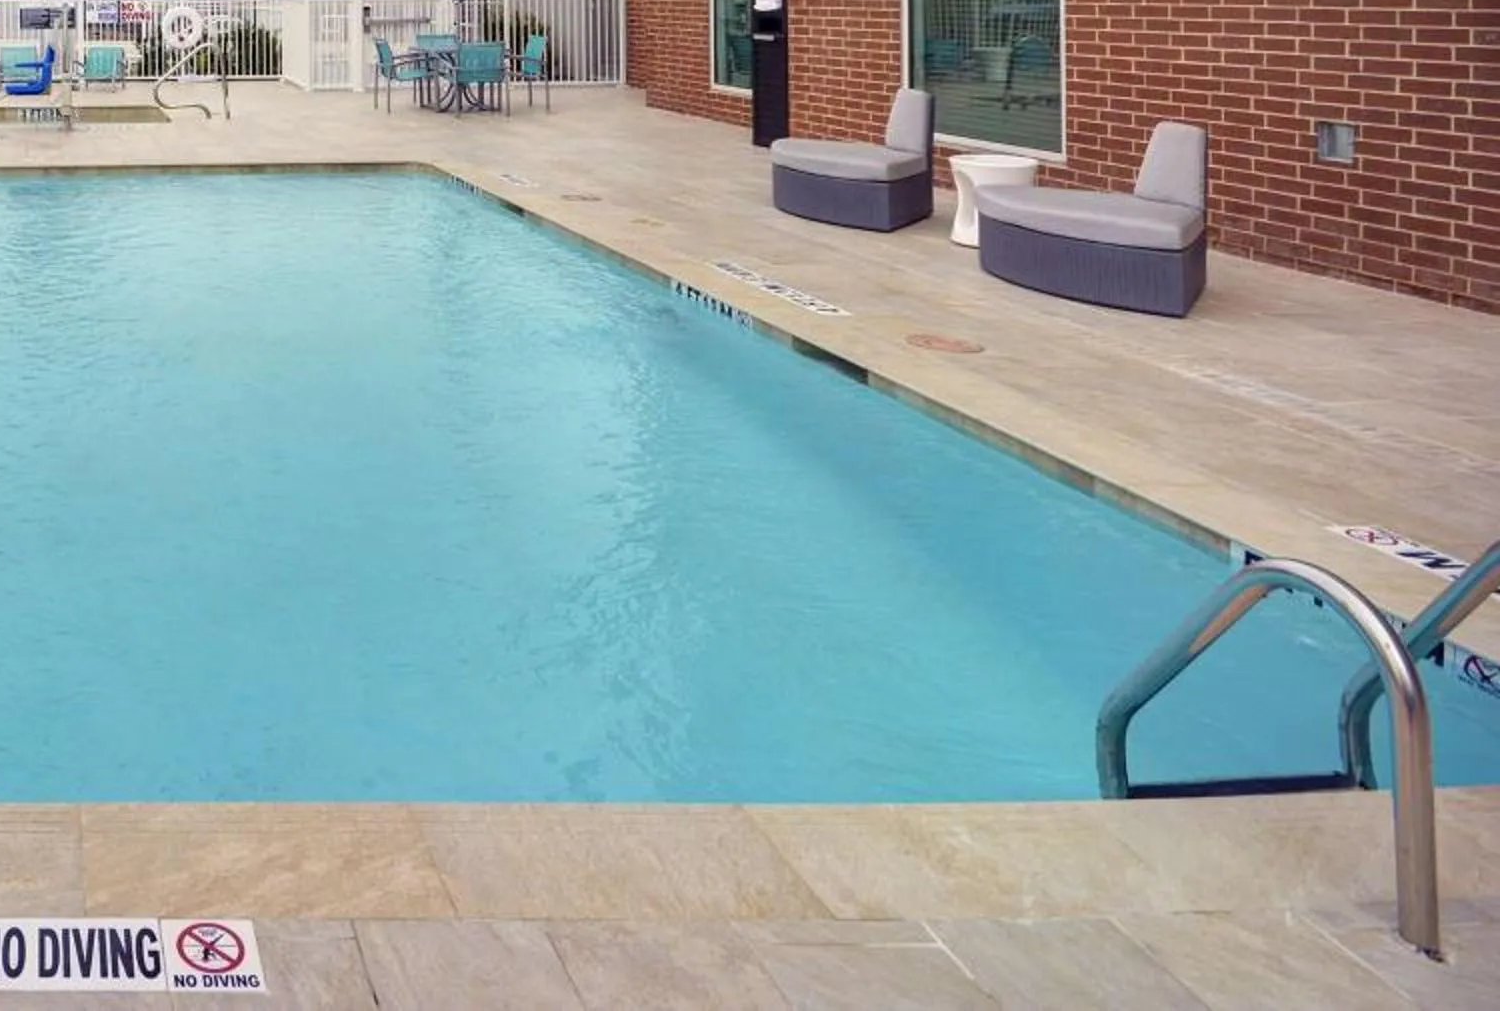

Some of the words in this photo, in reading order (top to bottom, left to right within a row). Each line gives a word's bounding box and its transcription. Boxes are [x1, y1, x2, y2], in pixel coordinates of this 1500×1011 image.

[38, 927, 162, 980] DIVING
[173, 974, 197, 988] NO
[202, 974, 261, 988] DIVING
